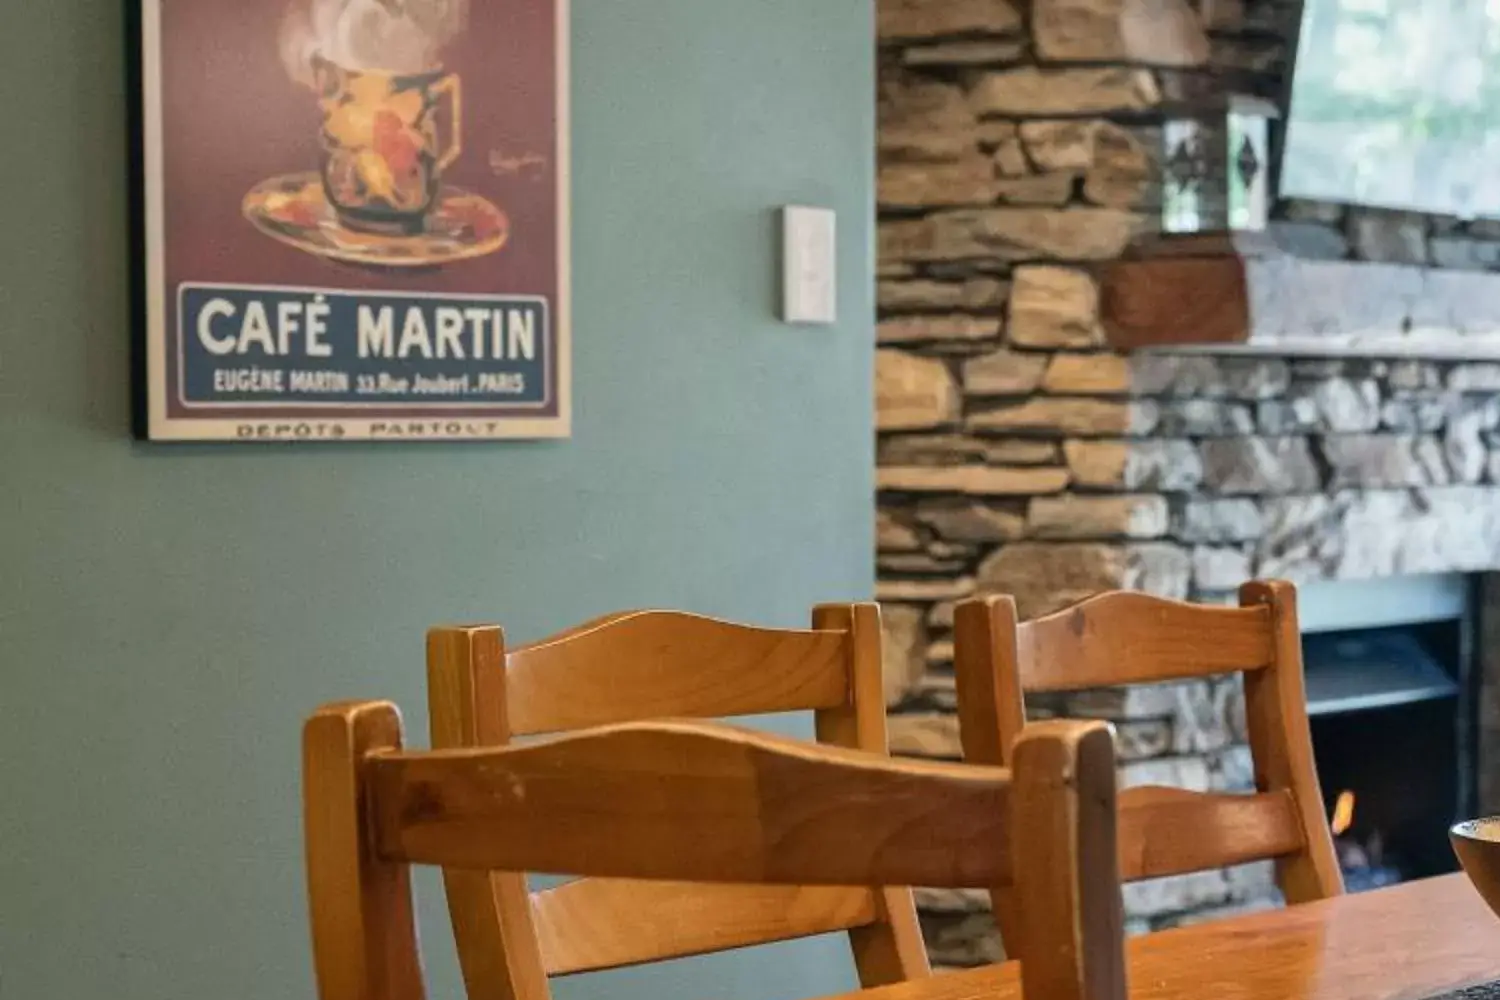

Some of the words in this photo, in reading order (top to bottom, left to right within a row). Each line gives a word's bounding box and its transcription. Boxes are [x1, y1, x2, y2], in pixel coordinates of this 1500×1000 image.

[197, 293, 333, 357] CAFÉ
[357, 304, 535, 361] MARTIN
[289, 368, 350, 393] MARTIN
